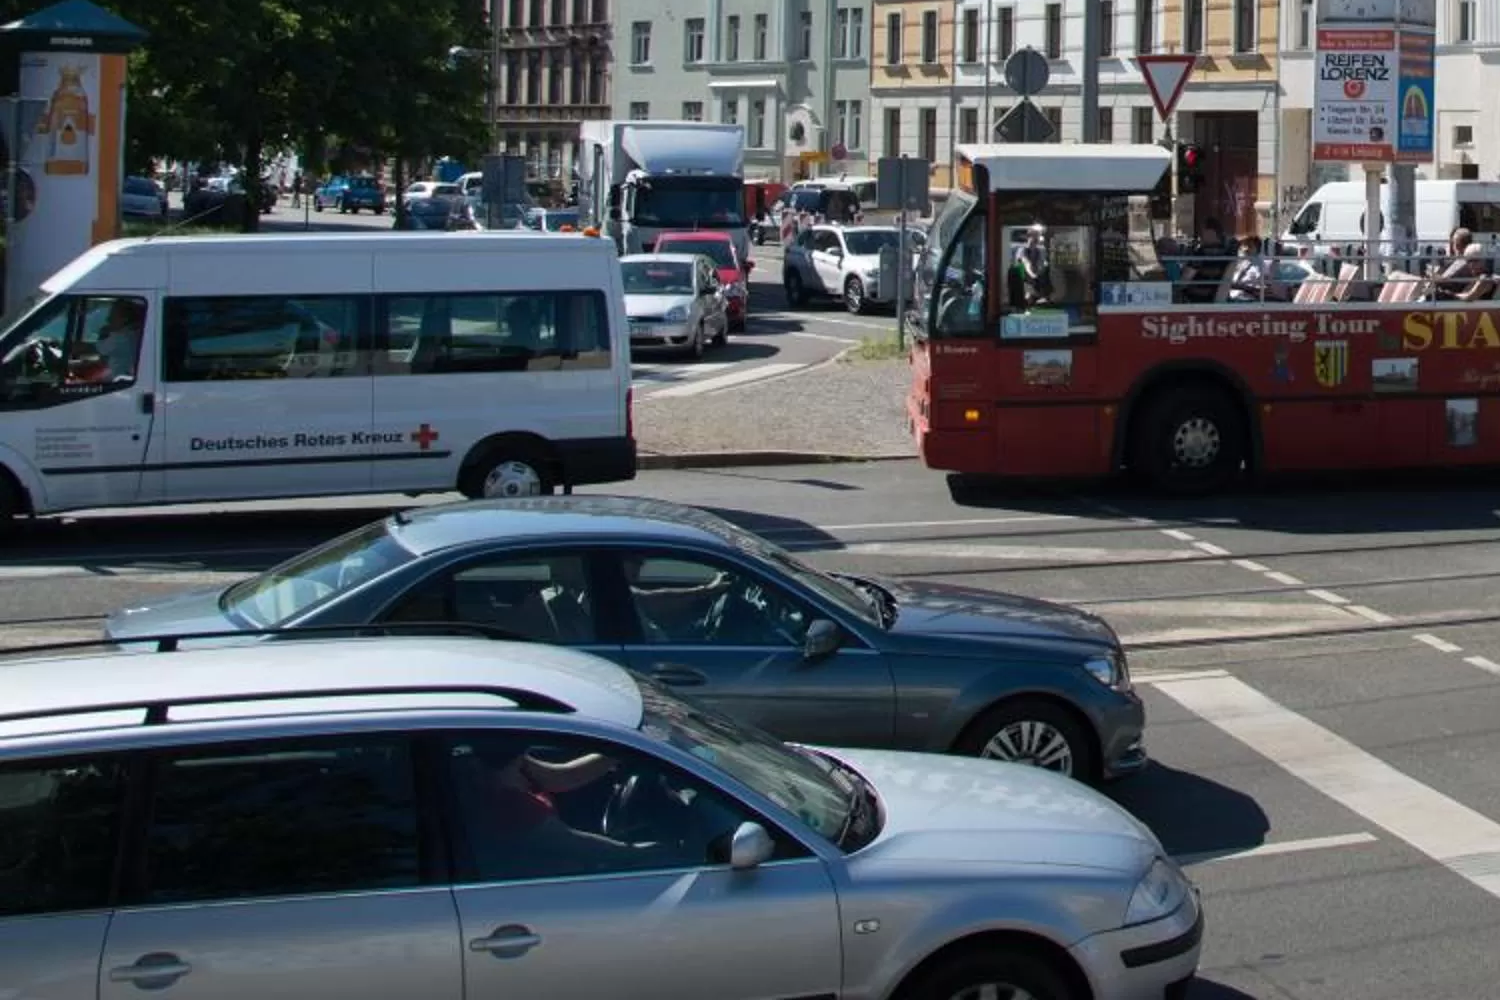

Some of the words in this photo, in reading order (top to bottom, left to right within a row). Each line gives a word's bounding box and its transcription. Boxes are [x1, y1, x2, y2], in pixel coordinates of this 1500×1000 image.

[1326, 54, 1385, 66] REIFEN
[1321, 67, 1389, 81] LORENZ
[1141, 314, 1308, 344] Sightseeing
[1313, 311, 1381, 335] Tour
[190, 432, 289, 451] Deutsches
[293, 431, 347, 448] Rotes
[351, 430, 404, 446] Kreuz
